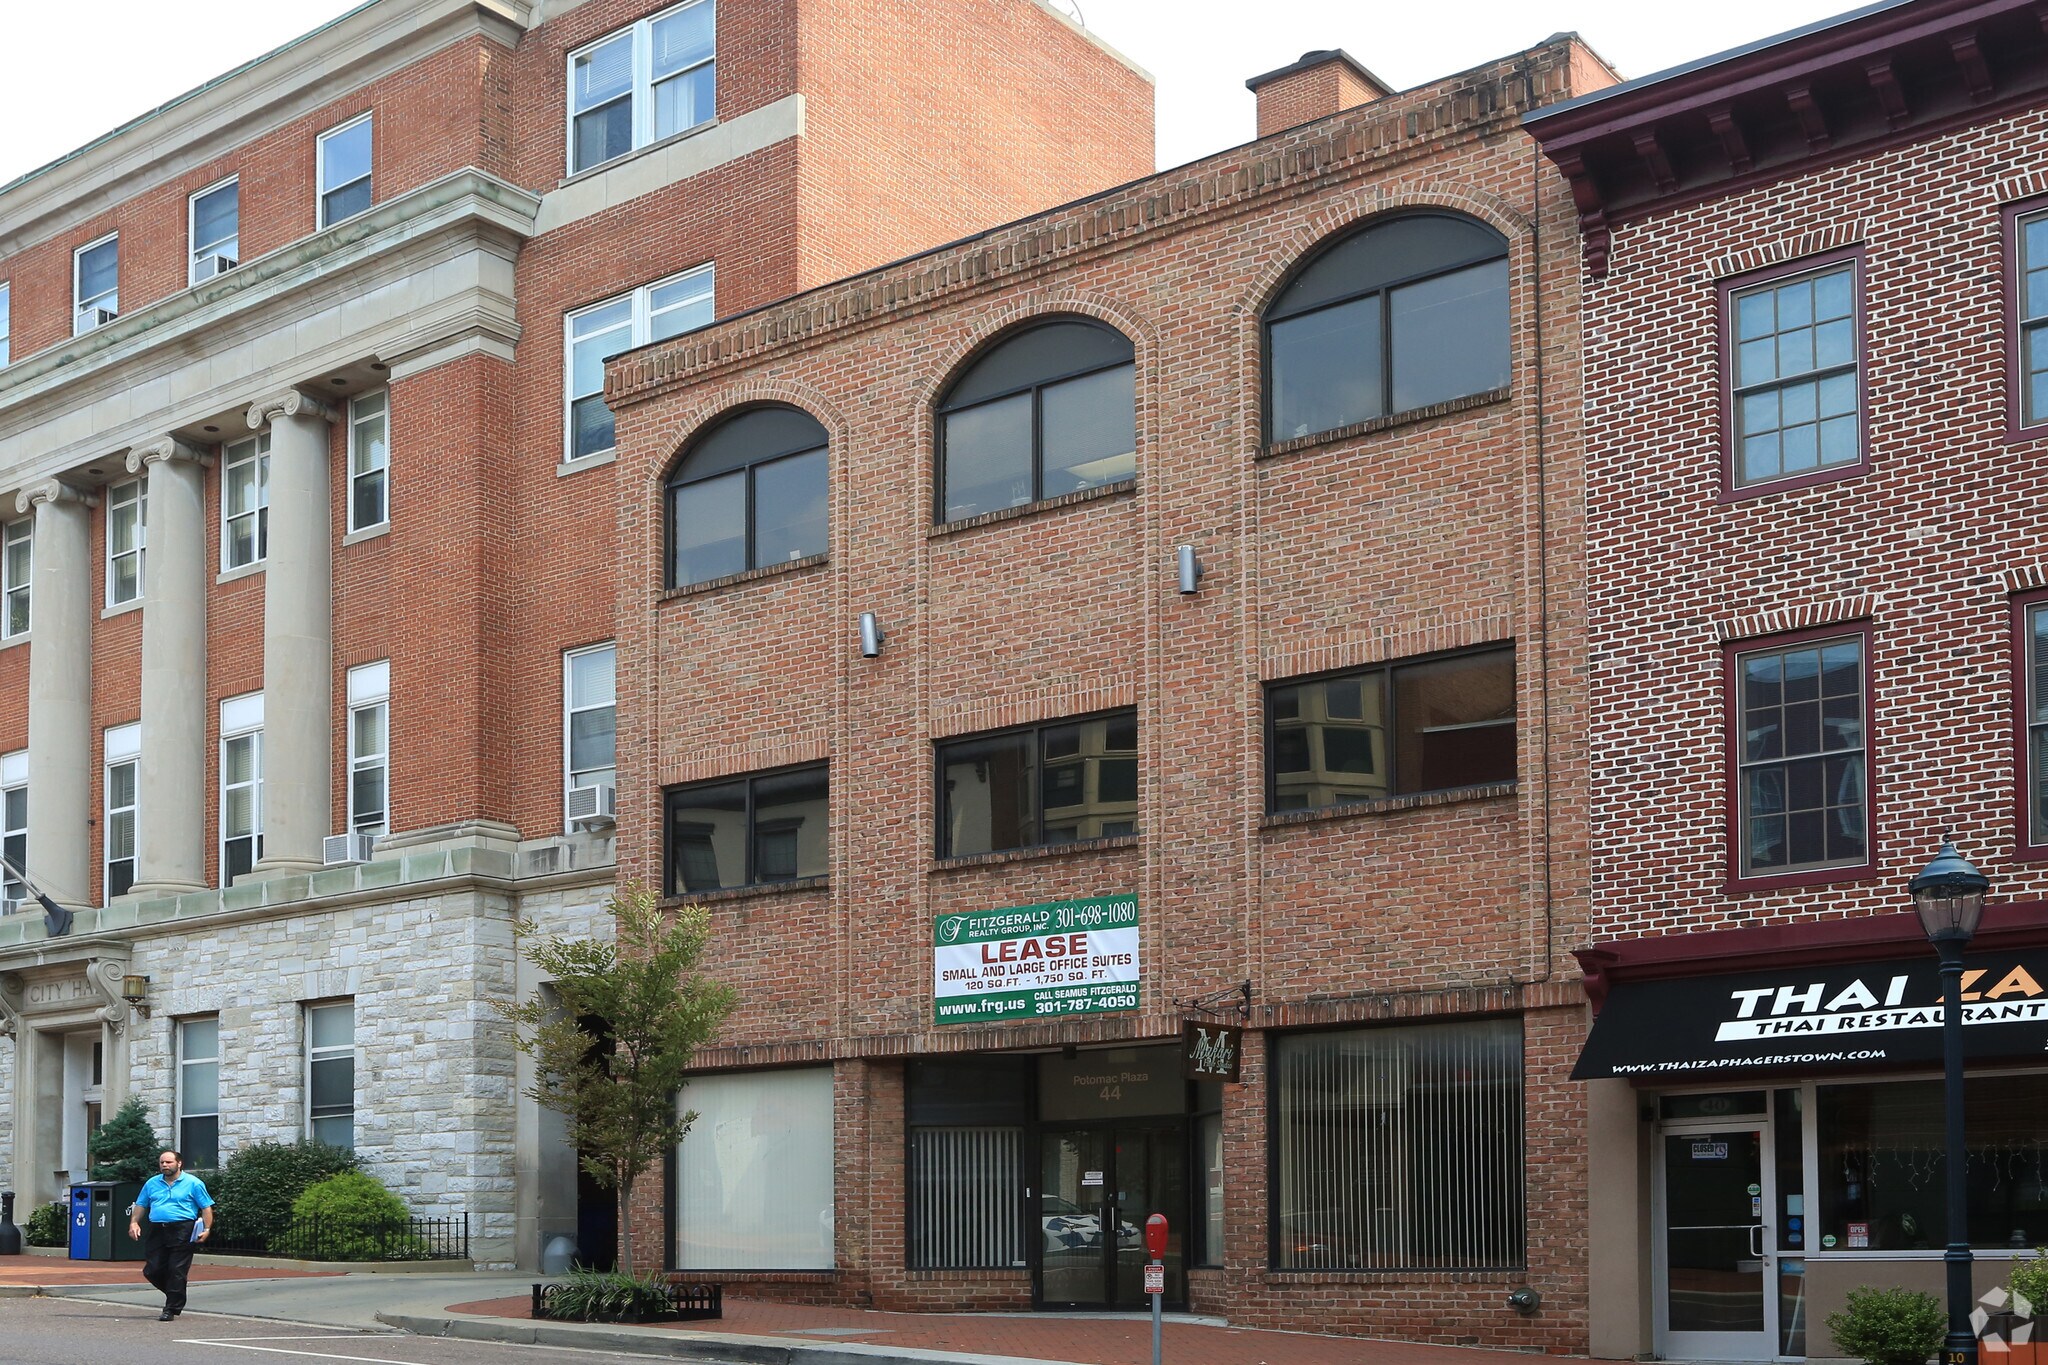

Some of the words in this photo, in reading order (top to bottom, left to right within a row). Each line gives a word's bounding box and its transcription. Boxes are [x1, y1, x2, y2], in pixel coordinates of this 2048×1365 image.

[969, 910, 1050, 930] FITZGERALD
[1055, 901, 1136, 929] 301-698-1080
[968, 928, 999, 938] REALTY
[1001, 925, 1032, 935] GROUP,
[1033, 922, 1050, 932] INC.
[981, 933, 1088, 964] LEASE
[942, 967, 978, 982] SMALL
[981, 965, 1006, 978] AND
[1009, 961, 1046, 975] LARGE
[1050, 957, 1088, 971] OFFICE
[1092, 953, 1132, 967] SUITES
[965, 981, 984, 990] 120
[1035, 973, 1064, 985] 1,750
[1068, 971, 1088, 981] SQ.
[1092, 969, 1108, 979] FT.
[31, 983, 63, 1002] CITY
[72, 980, 99, 998] HA
[1034, 990, 1053, 1001] CALL
[1055, 987, 1088, 999] SEAMUS
[1090, 984, 1137, 996] FITZGERALD
[1730, 975, 1909, 1019] THAI
[939, 999, 1026, 1016] www.frg.us
[1035, 995, 1136, 1015] 301-787-4050
[1756, 1018, 1826, 1036] THAI
[1612, 1049, 1886, 1074] WWW.THAIZAPHAGERSTOWN.COM
[1073, 1073, 1117, 1086] Potomac
[1121, 1072, 1149, 1082] Plaza
[1099, 1085, 1121, 1100] 44
[1850, 1225, 1866, 1234] OPEN
[1949, 1352, 1965, 1364] 10
